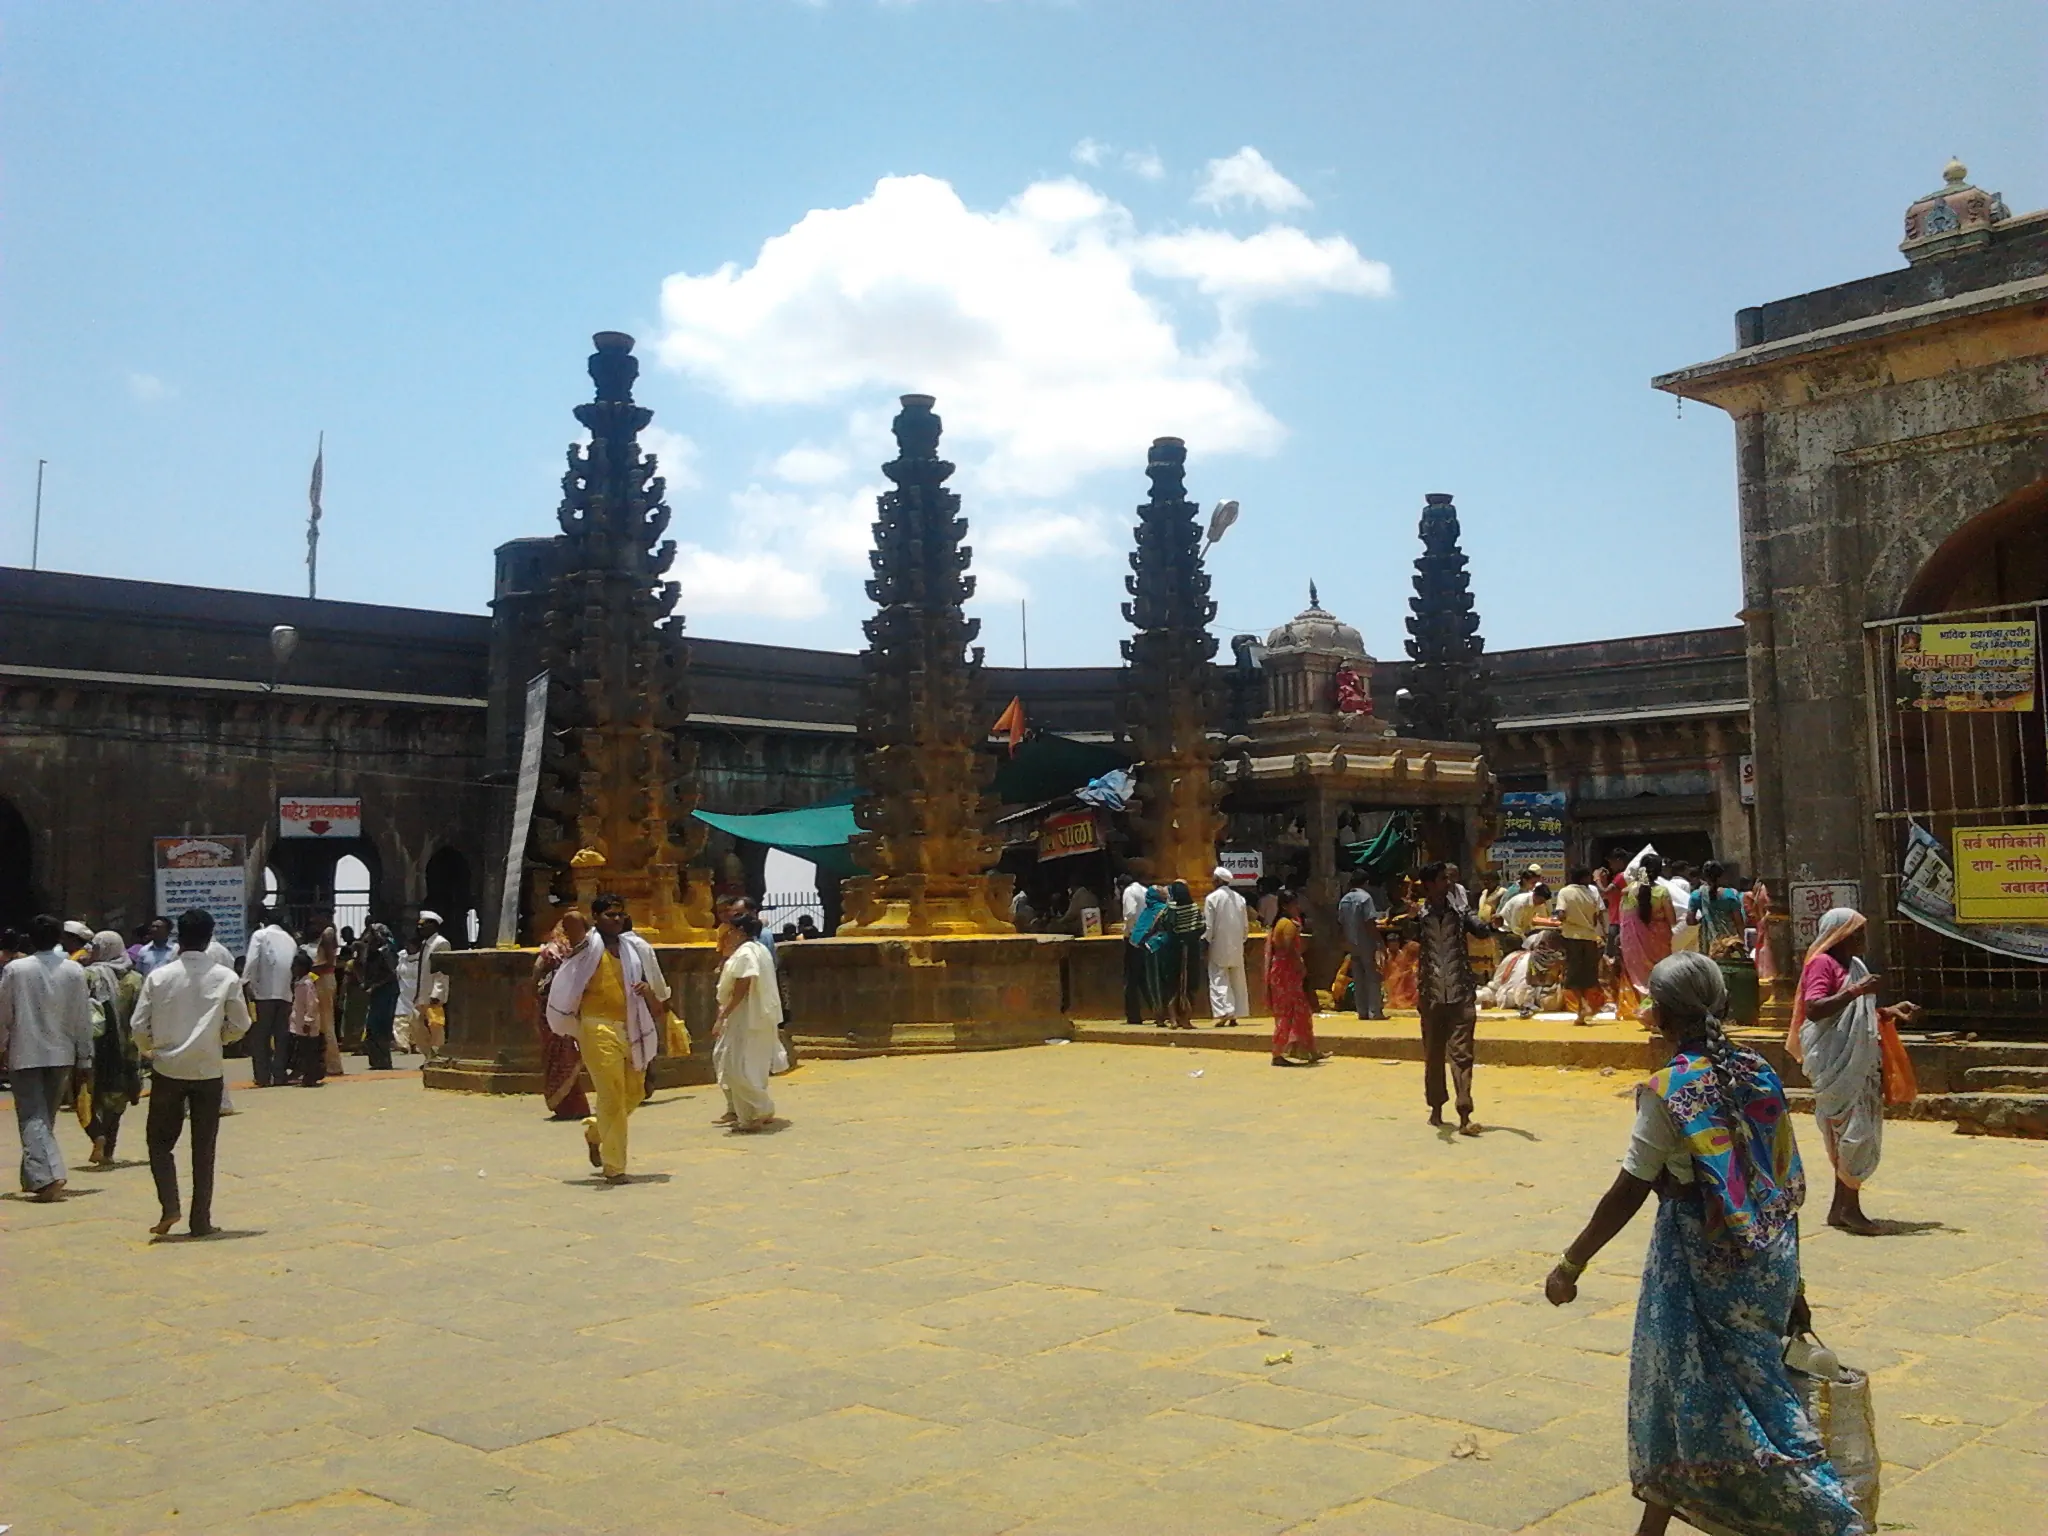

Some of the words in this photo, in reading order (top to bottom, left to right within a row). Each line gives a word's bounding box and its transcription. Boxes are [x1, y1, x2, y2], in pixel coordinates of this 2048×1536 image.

[1962, 833, 1982, 850] सर्व
[1986, 832, 2045, 849] भाविकांनी
[2001, 881, 2048, 894] जबाबदा
